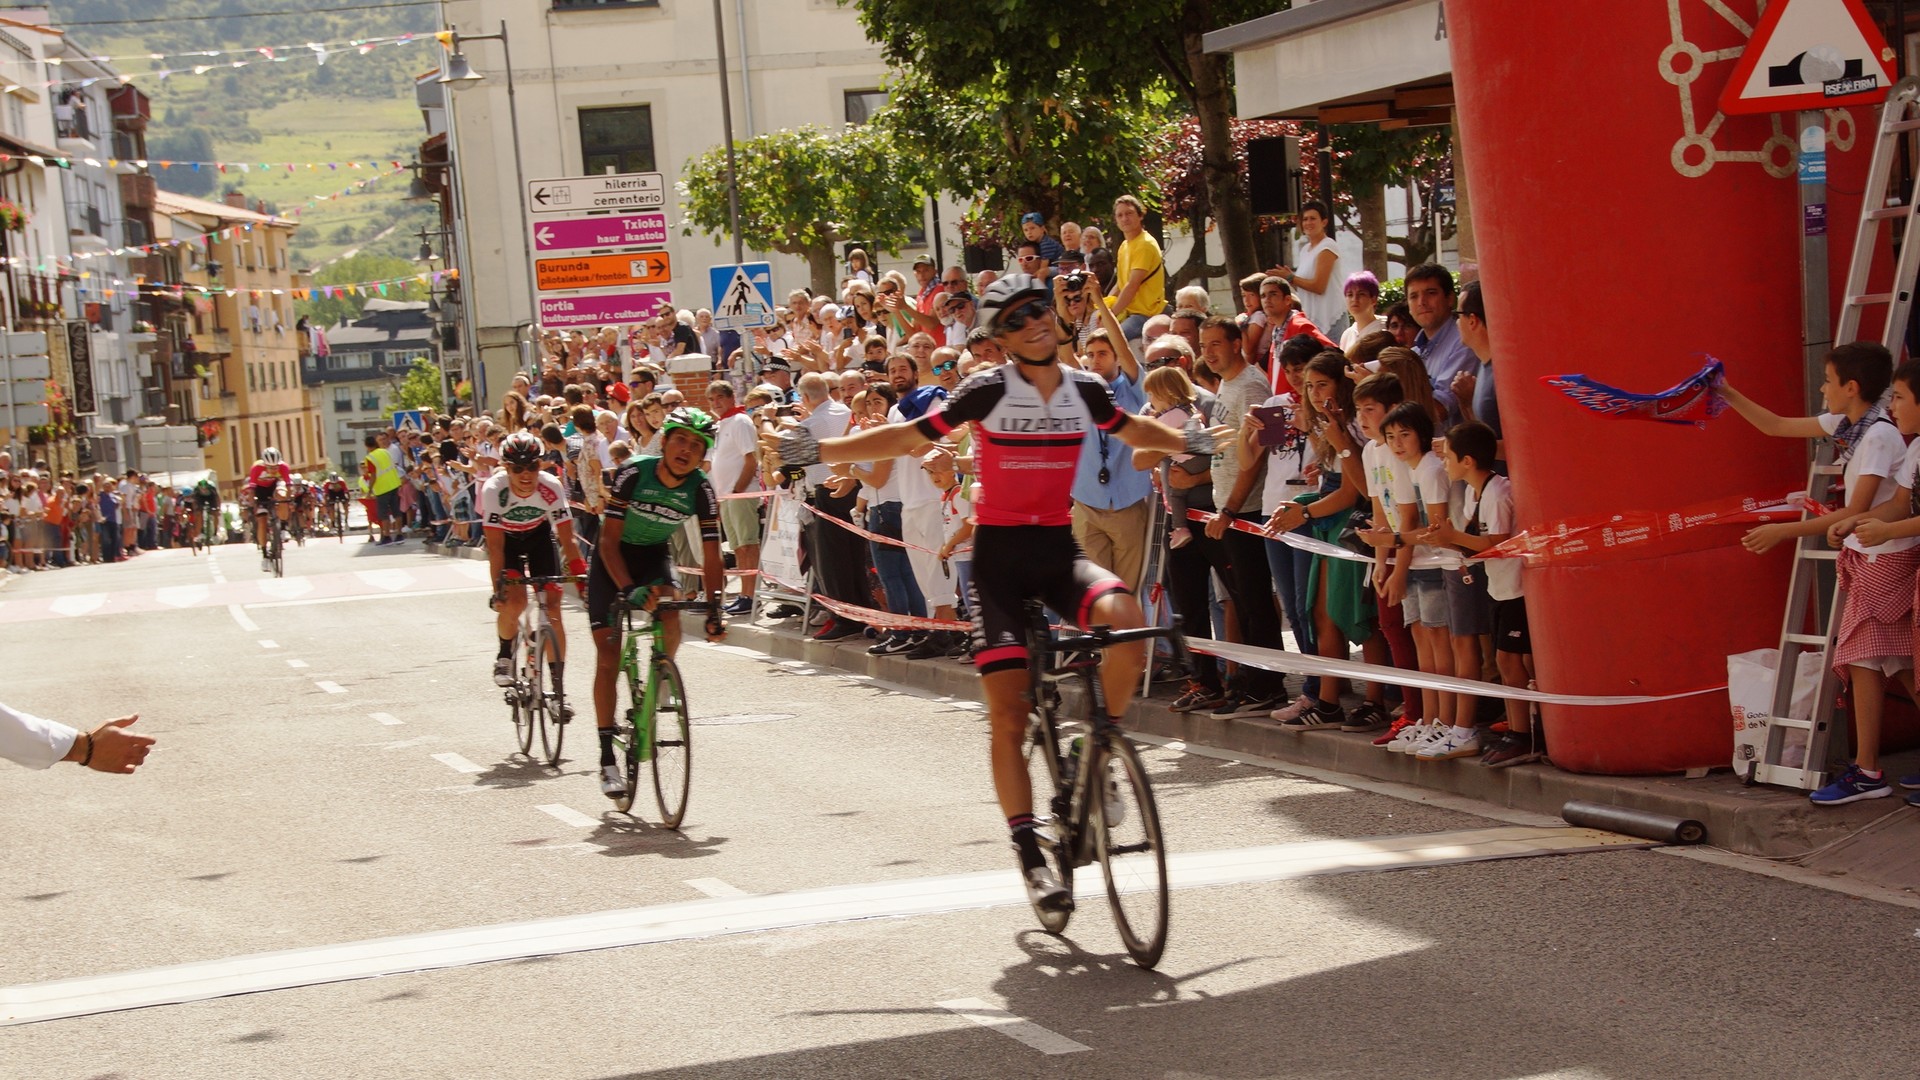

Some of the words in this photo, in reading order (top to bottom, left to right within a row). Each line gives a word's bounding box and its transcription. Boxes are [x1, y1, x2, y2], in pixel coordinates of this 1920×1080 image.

[605, 178, 647, 189] hilerria
[594, 193, 660, 205] cementerio
[622, 218, 663, 230] Txioka
[597, 235, 620, 243] haur
[539, 262, 590, 273] Burunda
[541, 301, 574, 312] Iortia
[614, 309, 650, 318] cultural
[1000, 417, 1082, 432] LIZARTE
[1684, 513, 1717, 524] Gobierno
[1615, 526, 1650, 538] Nafarroako
[1617, 534, 1649, 545] Gobernua
[1748, 721, 1758, 729] de
